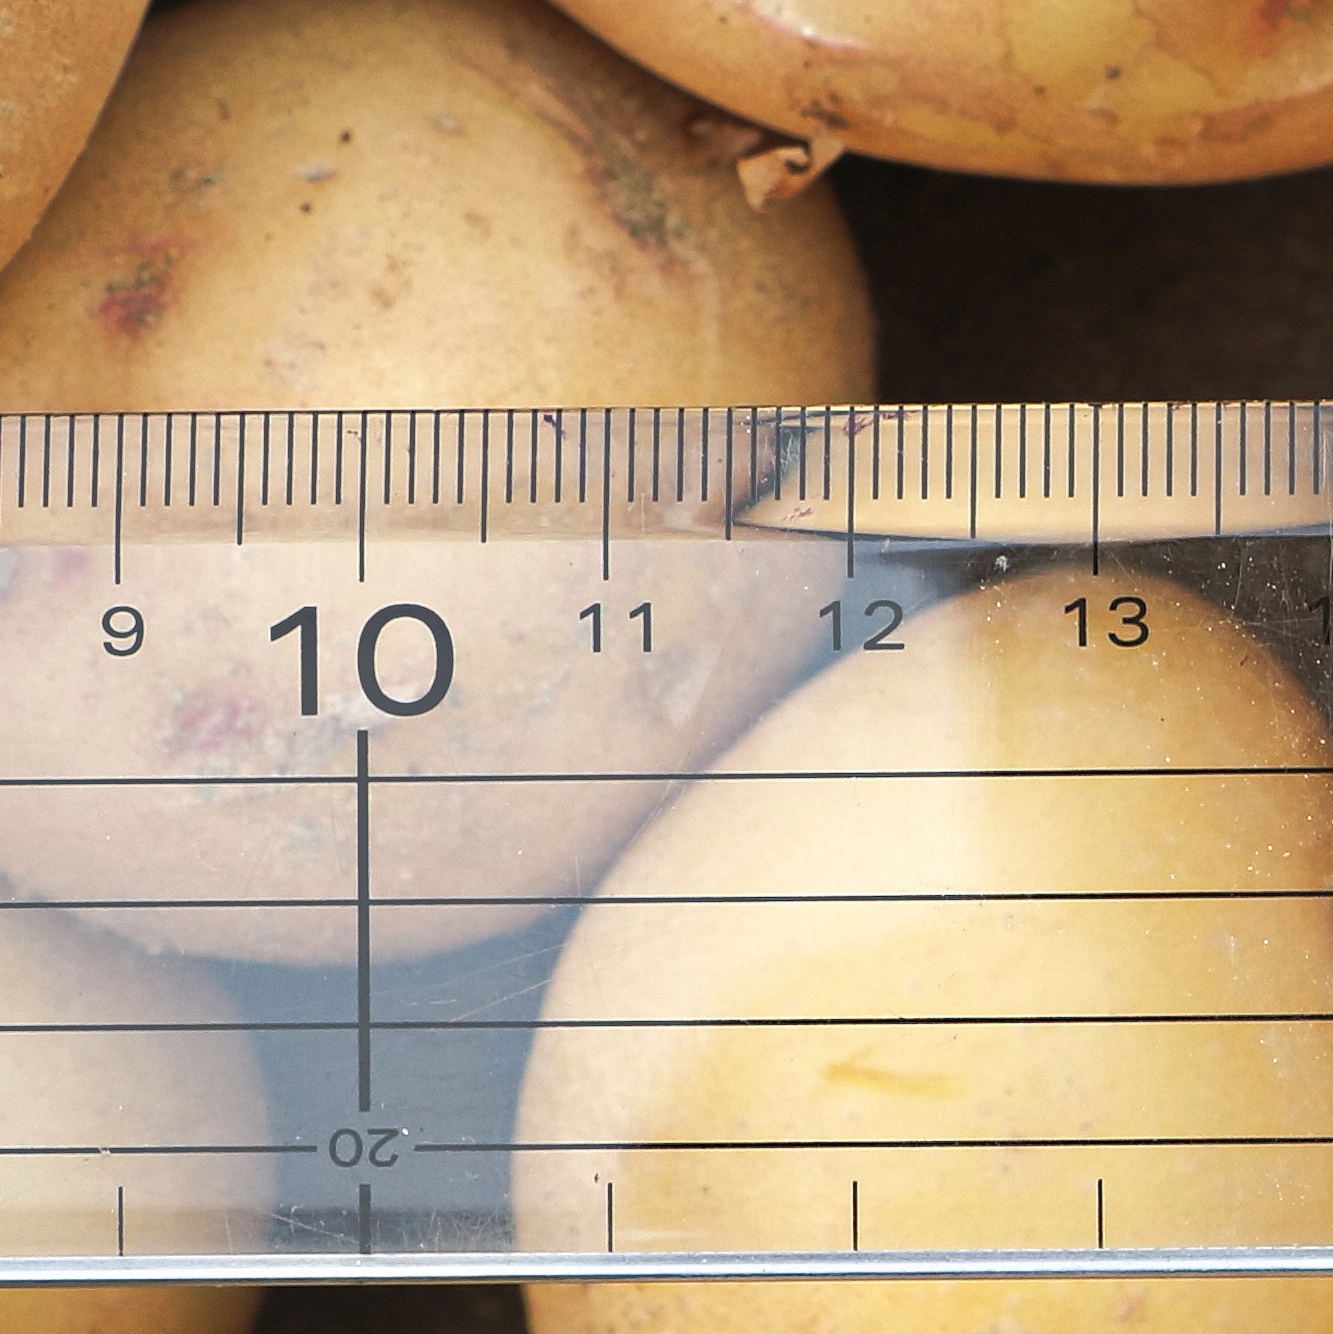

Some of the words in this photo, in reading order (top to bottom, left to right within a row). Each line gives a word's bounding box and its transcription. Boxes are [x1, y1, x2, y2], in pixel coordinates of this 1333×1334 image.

[102, 606, 144, 656] 9
[271, 604, 454, 716] 10
[580, 603, 651, 652] 11
[820, 600, 904, 651] 12
[1065, 597, 1148, 647] 13
[329, 1129, 399, 1167] 20
